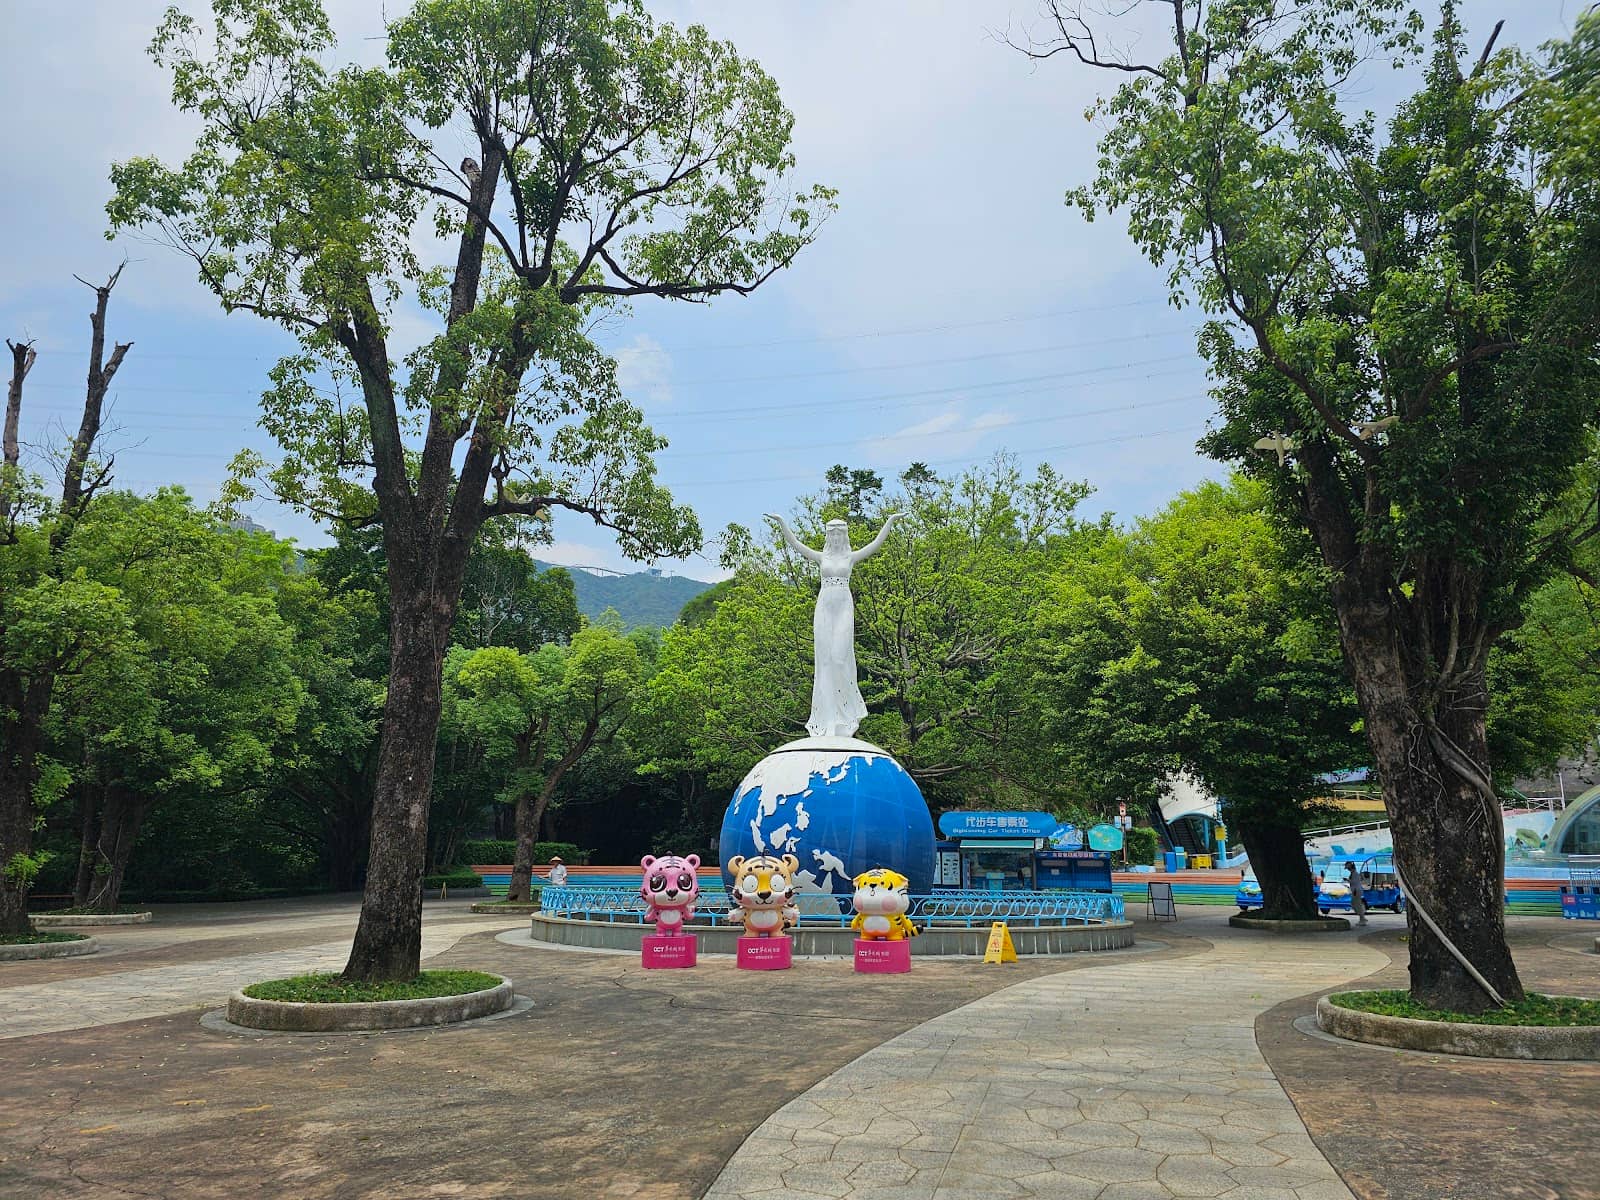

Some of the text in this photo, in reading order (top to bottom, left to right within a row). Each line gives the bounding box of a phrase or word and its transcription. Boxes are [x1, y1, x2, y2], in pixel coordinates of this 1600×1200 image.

[966, 816, 1029, 828] 代步车售票处
